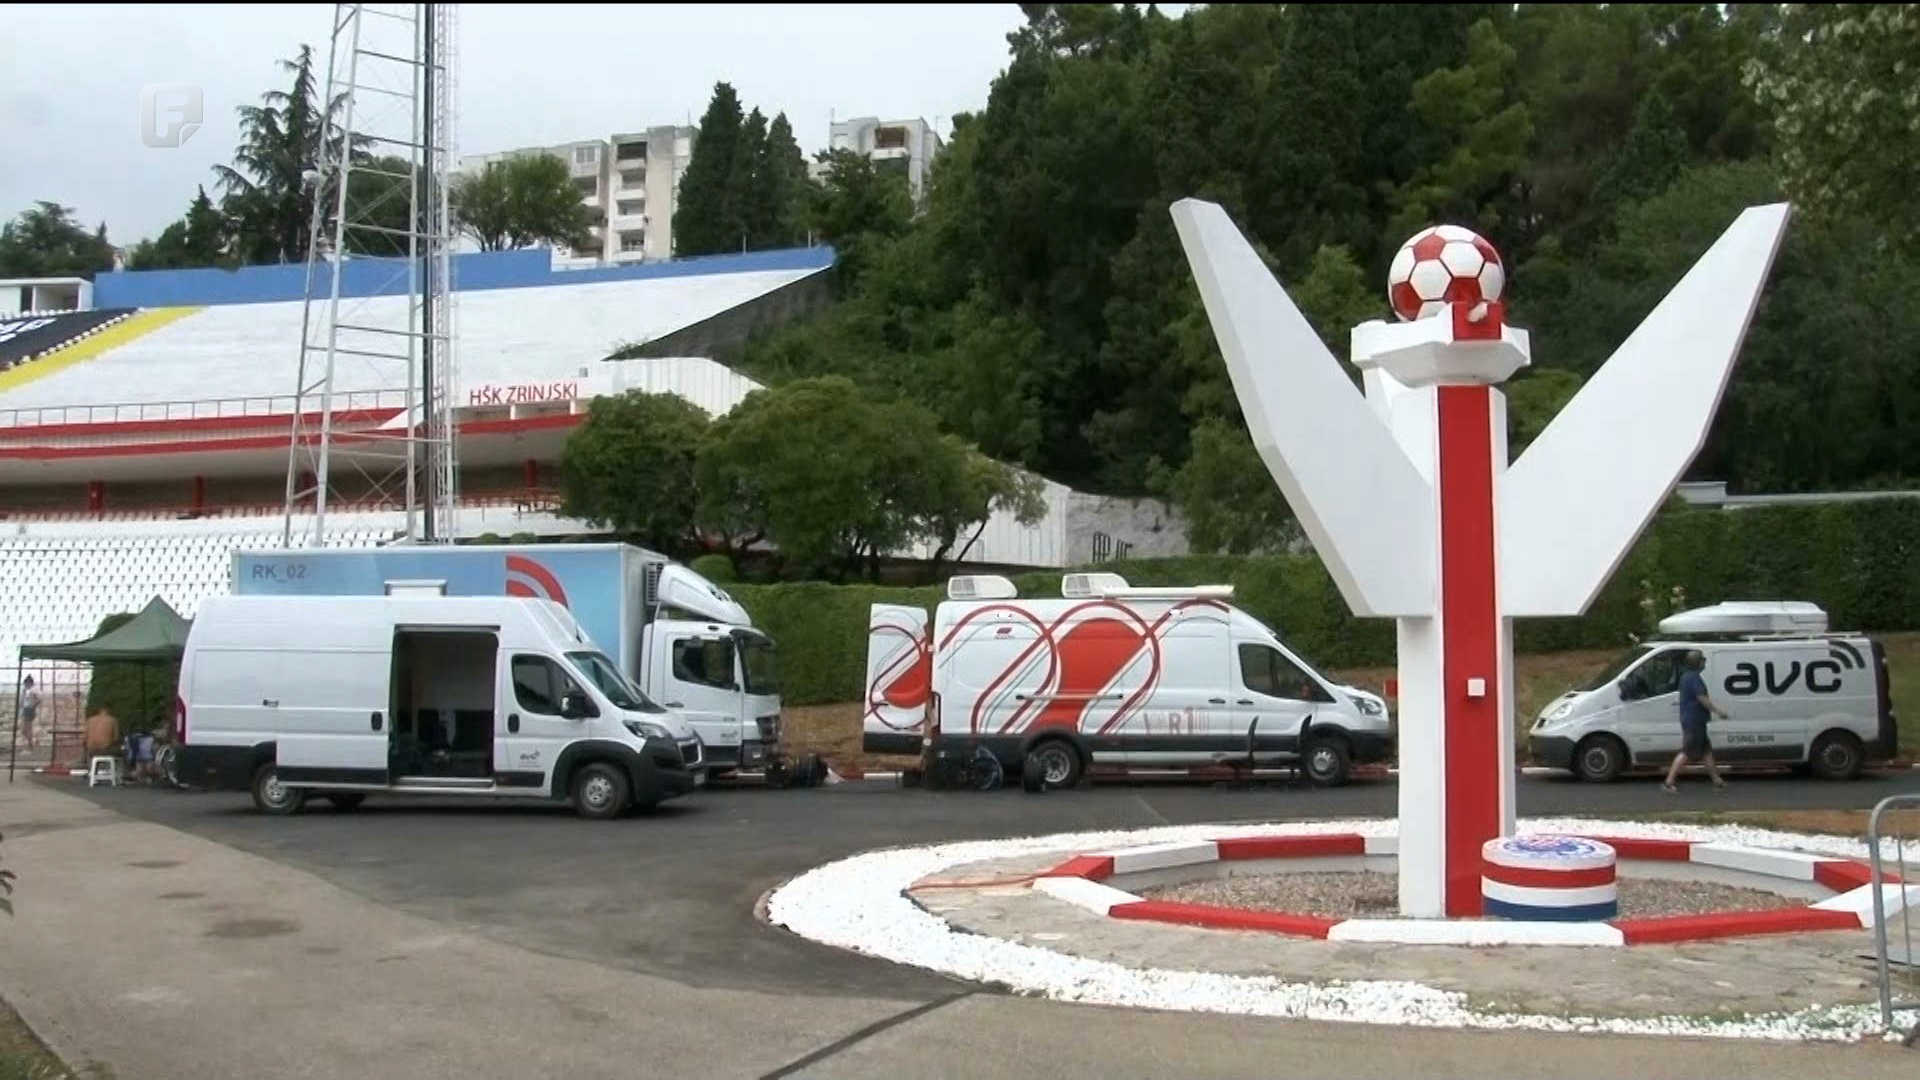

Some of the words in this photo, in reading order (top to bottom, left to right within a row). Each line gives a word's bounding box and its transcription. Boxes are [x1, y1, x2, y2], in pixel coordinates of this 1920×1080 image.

[470, 384, 502, 405] HŠK
[507, 382, 577, 402] ZRINJSKI
[252, 564, 307, 583] RK_02
[1724, 661, 1842, 695] avc
